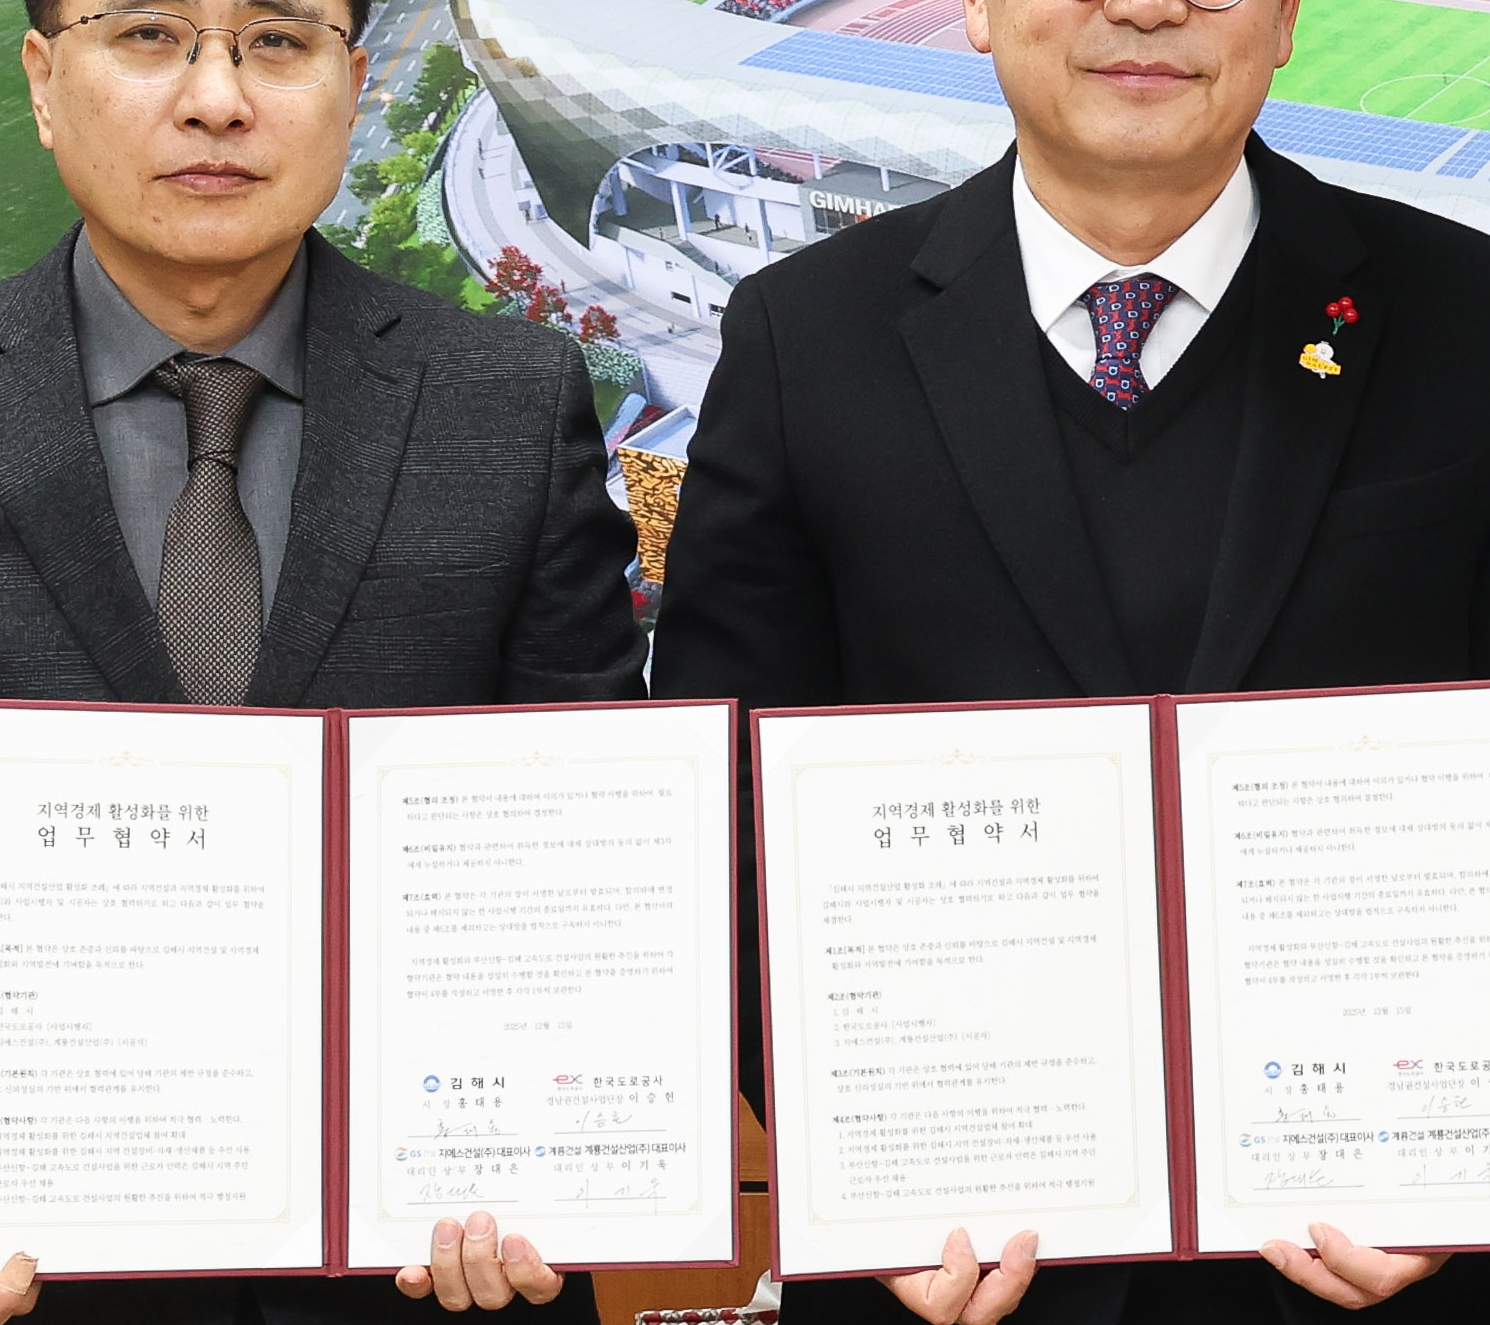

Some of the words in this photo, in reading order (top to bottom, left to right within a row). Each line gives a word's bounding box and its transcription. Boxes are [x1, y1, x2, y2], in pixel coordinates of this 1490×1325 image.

[36, 801, 102, 820] 지역경제
[107, 802, 172, 821] 활성화를
[178, 803, 210, 822] 위한
[872, 801, 935, 820] 지역경제
[940, 798, 1004, 818] 활성화를
[1010, 797, 1042, 815] 위한
[592, 1075, 663, 1088] 한국도로공사
